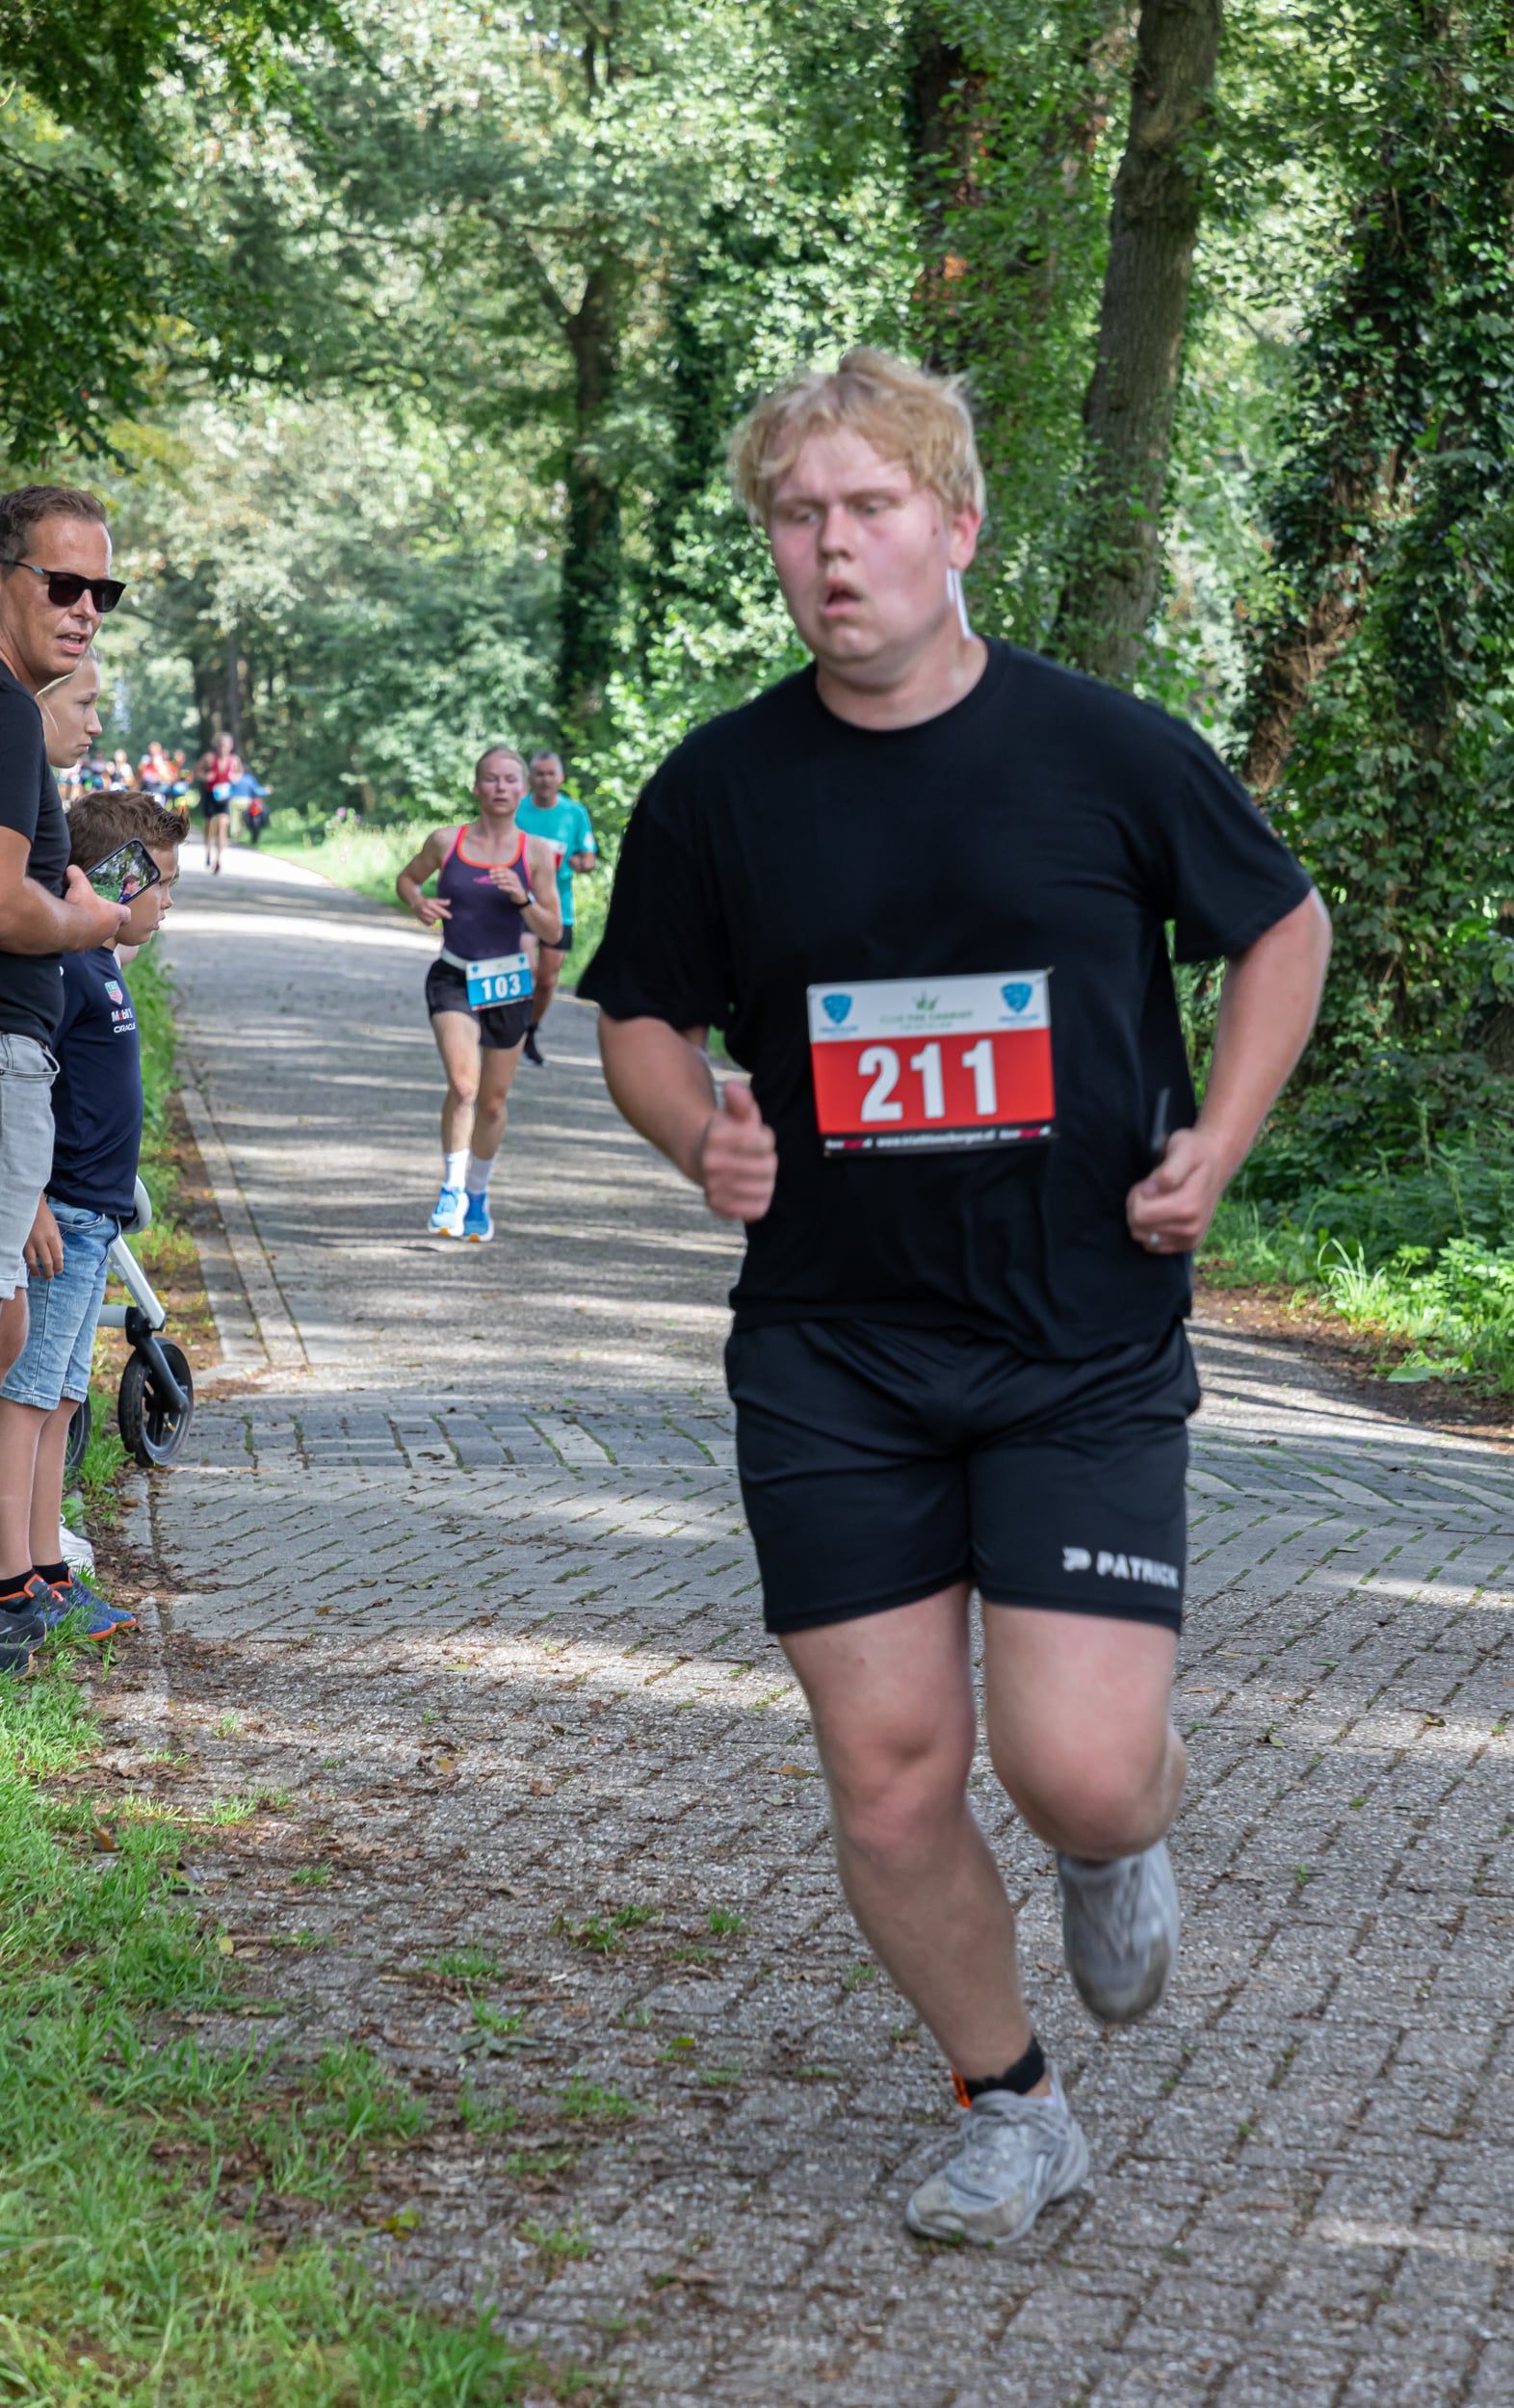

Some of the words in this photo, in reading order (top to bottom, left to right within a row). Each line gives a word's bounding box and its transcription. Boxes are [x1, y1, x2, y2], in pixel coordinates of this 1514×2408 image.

[482, 973, 521, 1001] 103
[858, 1038, 998, 1122] 211
[1096, 1550, 1179, 1589] PATRICK
